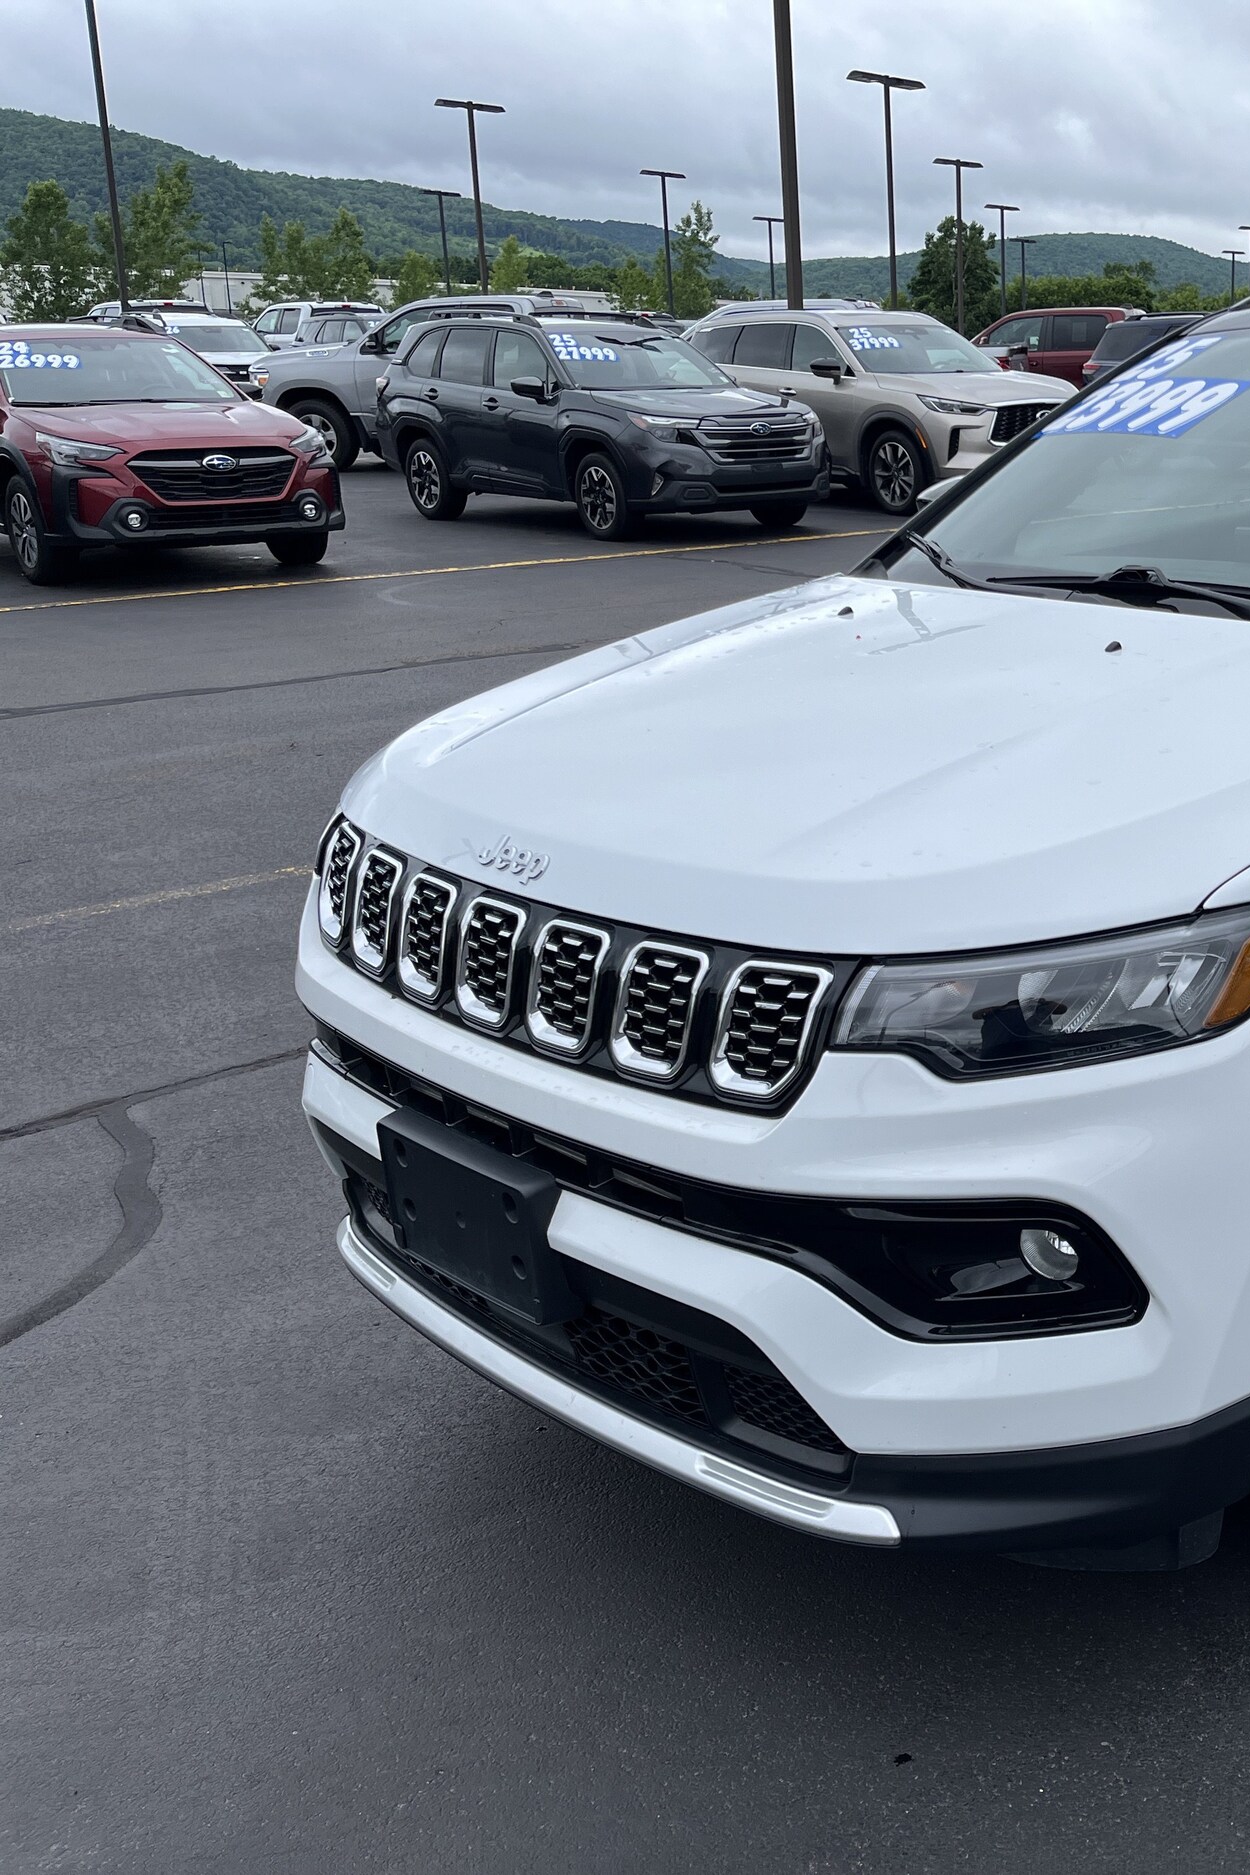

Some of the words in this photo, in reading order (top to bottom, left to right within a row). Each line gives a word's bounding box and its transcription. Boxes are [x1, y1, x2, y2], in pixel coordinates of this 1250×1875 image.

[165, 326, 180, 335] 26
[849, 327, 872, 339] 25
[549, 334, 578, 346] 25
[849, 337, 899, 351] 37999
[0, 341, 30, 355] 24
[555, 346, 617, 361] 27999
[0, 354, 80, 369] 26999
[1110, 336, 1222, 383] 25
[1042, 380, 1240, 434] 23999
[478, 834, 551, 886] Jeep
